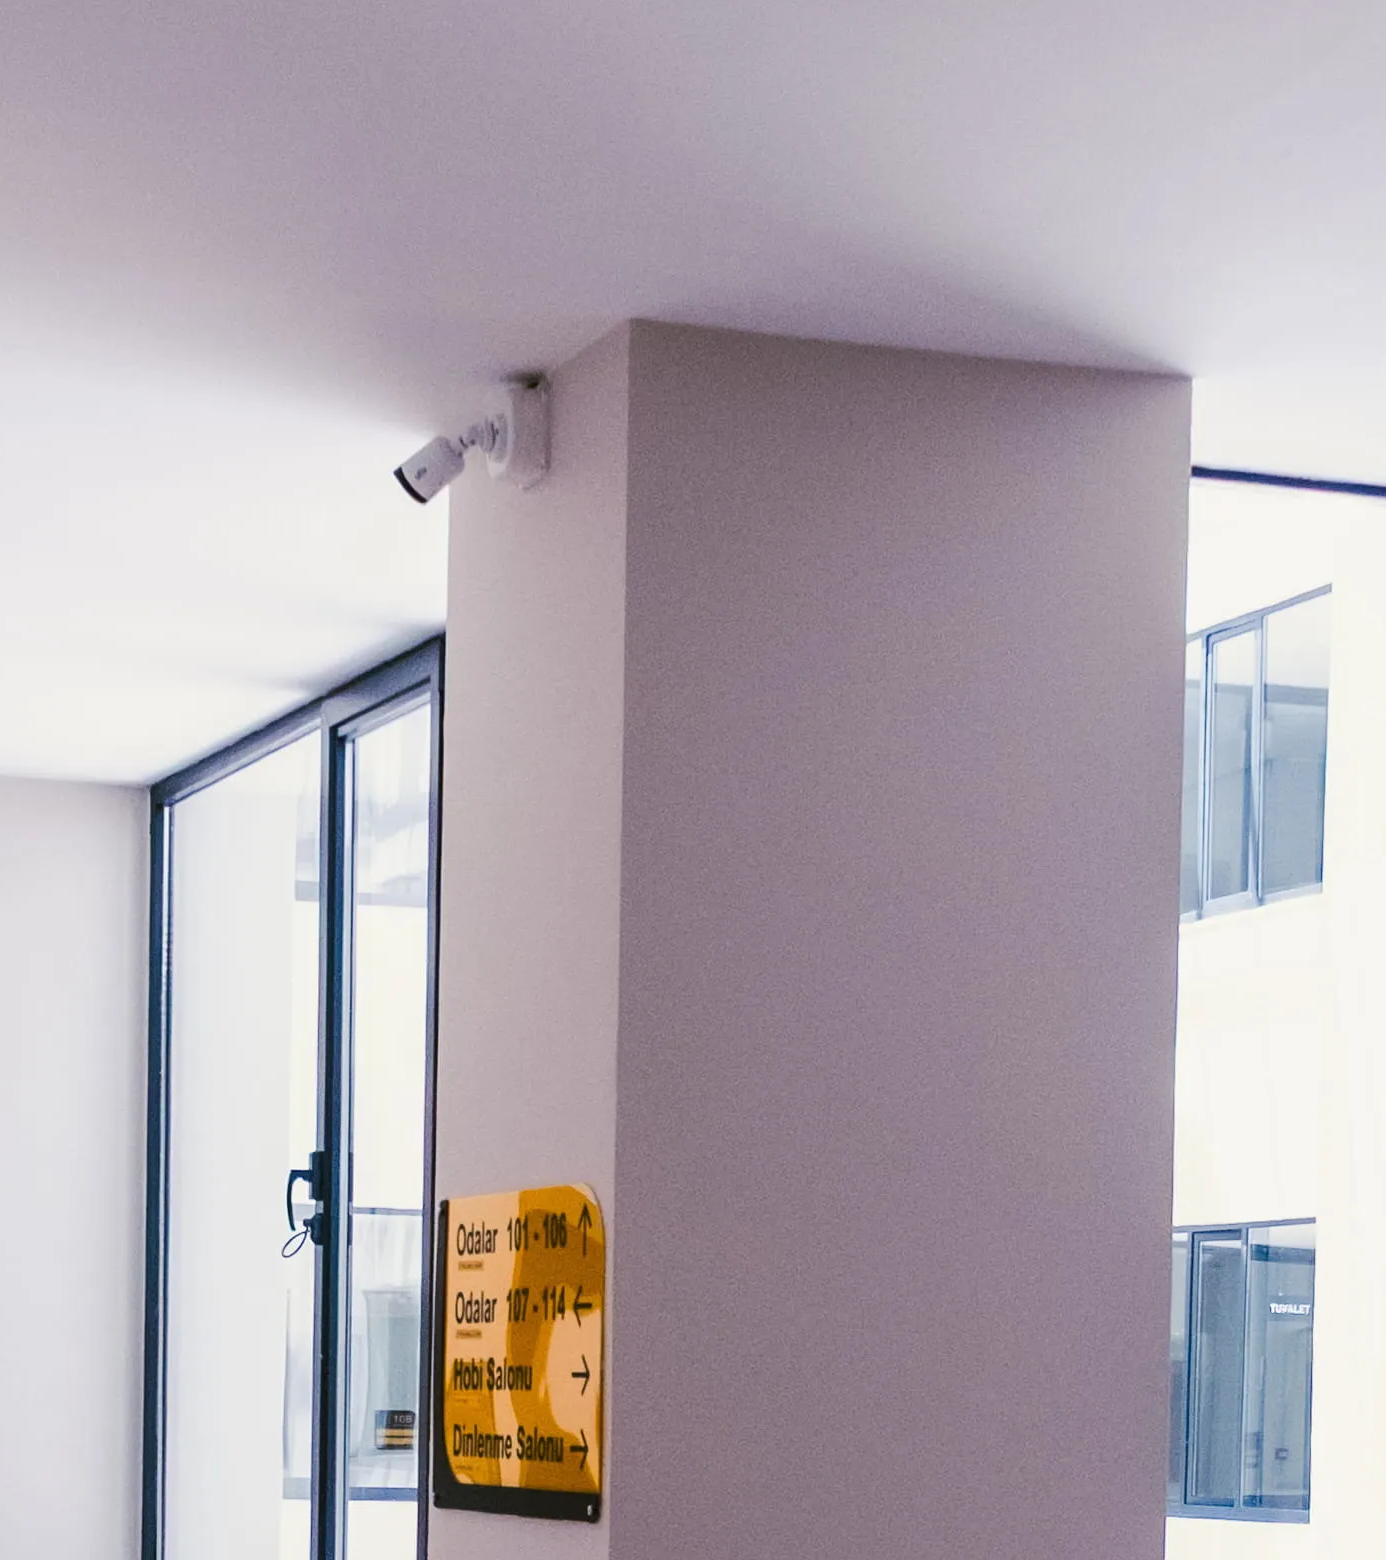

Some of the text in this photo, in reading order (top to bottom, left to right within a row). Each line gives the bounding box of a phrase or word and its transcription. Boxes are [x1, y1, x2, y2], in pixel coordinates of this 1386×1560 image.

[456, 1221, 498, 1256] Odalar
[507, 1216, 529, 1252] 101
[455, 1290, 497, 1324] Odalar
[506, 1287, 529, 1322] 107
[542, 1285, 565, 1320] 114
[1269, 1303, 1310, 1315] TUVALET
[453, 1356, 532, 1391] Hobi Salonu
[453, 1424, 564, 1462] Dinlenme Salonu
